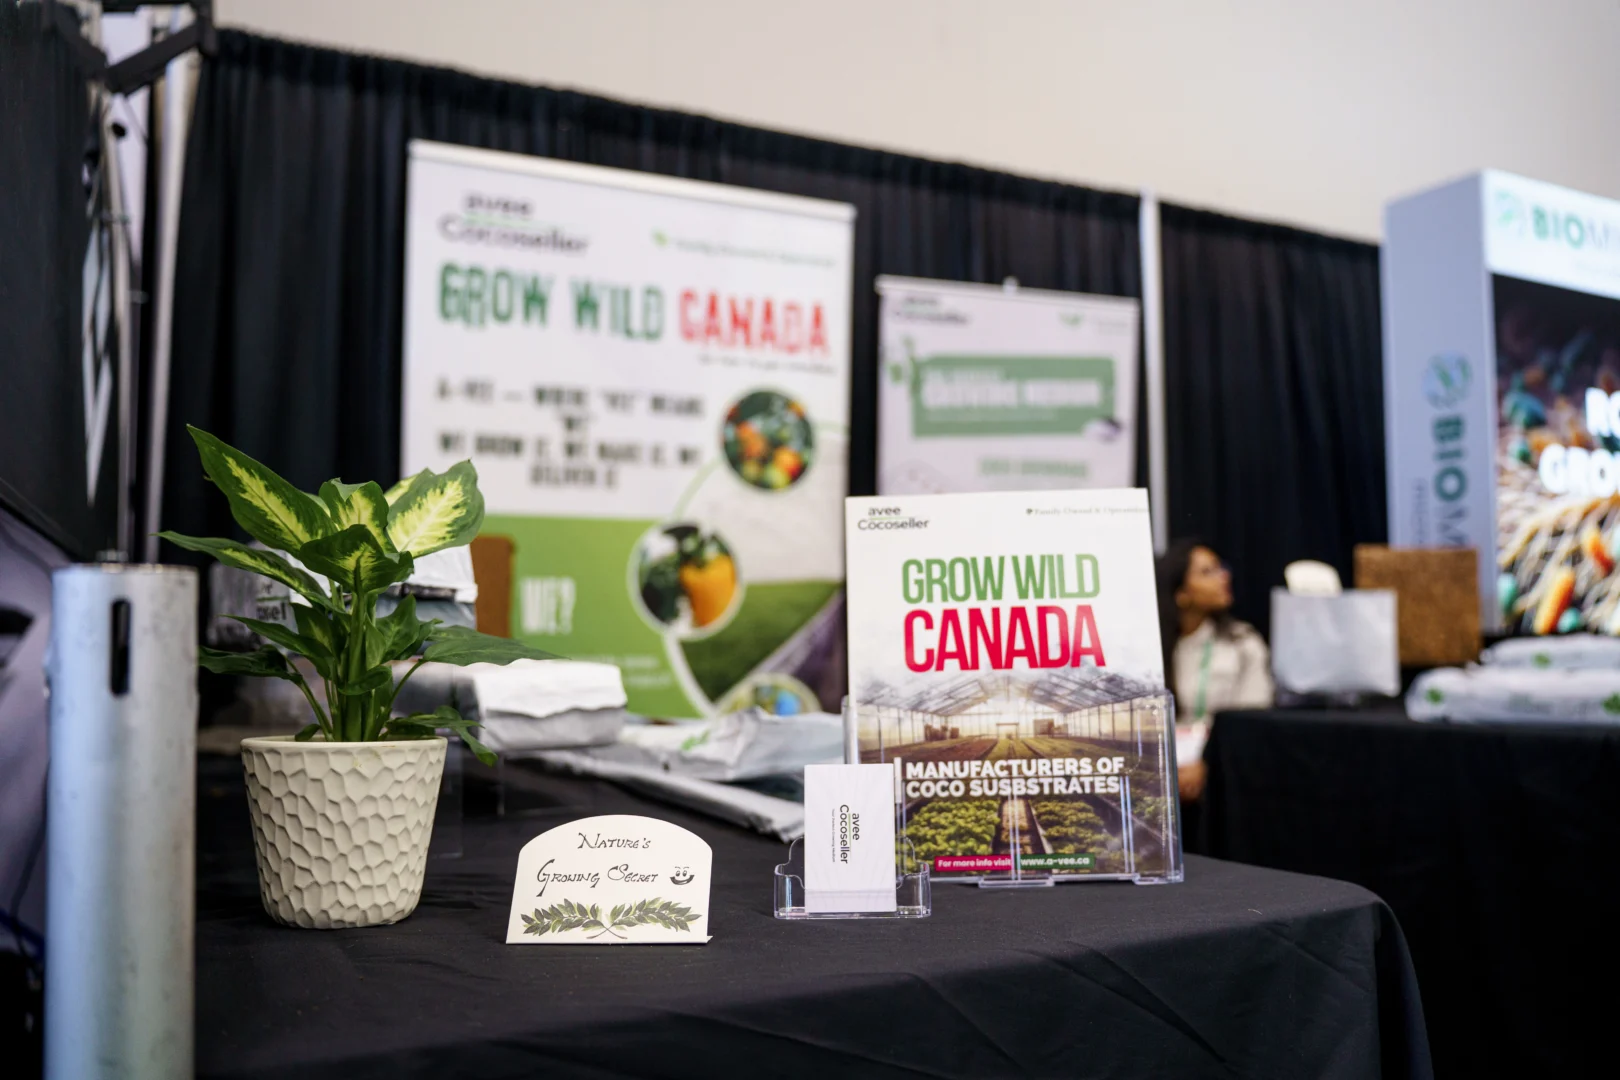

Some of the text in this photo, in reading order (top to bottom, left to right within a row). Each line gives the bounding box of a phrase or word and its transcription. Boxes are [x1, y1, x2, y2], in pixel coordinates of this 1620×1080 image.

[438, 262, 554, 329] GROW
[570, 276, 664, 341] WILD
[679, 287, 831, 356] CANADA
[857, 517, 930, 531] Cocoseller
[868, 506, 902, 516] avee
[902, 554, 1101, 604] GROW WILD
[904, 604, 1107, 673] CANADA
[906, 756, 1125, 780] MANUFACTURERS OF
[906, 776, 1121, 798] COCO SUSBSTRATES
[839, 804, 850, 864] Cocoseller
[851, 813, 861, 841] avee
[938, 857, 1090, 868] For more info visit www.a-vee.ca
